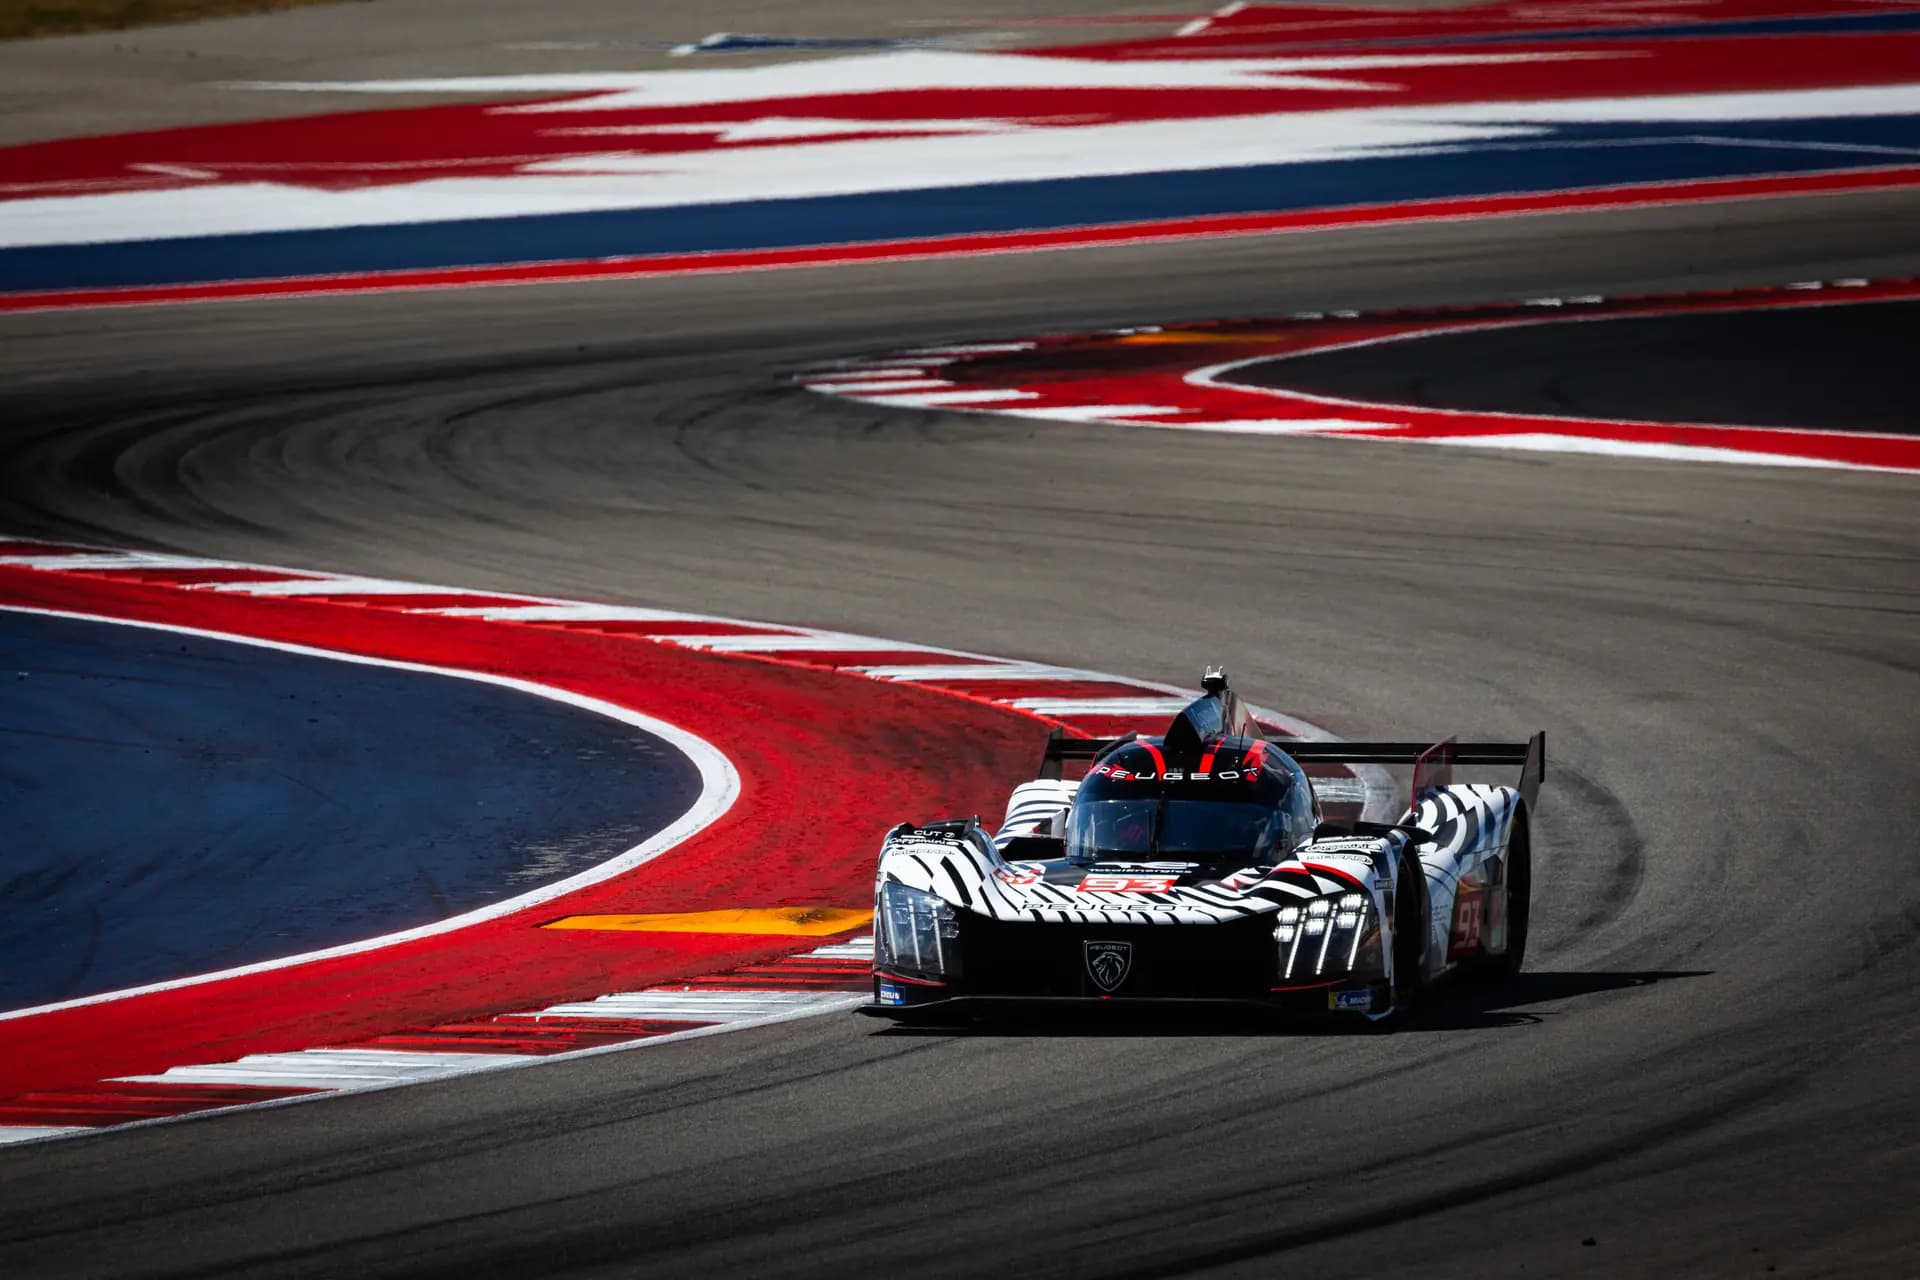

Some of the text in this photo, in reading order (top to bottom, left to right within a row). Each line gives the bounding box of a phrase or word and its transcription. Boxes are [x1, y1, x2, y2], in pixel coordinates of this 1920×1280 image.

[1096, 766, 1258, 781] PEUGEOT
[1081, 878, 1170, 893] 93
[1022, 902, 1201, 913] PEUGEOT
